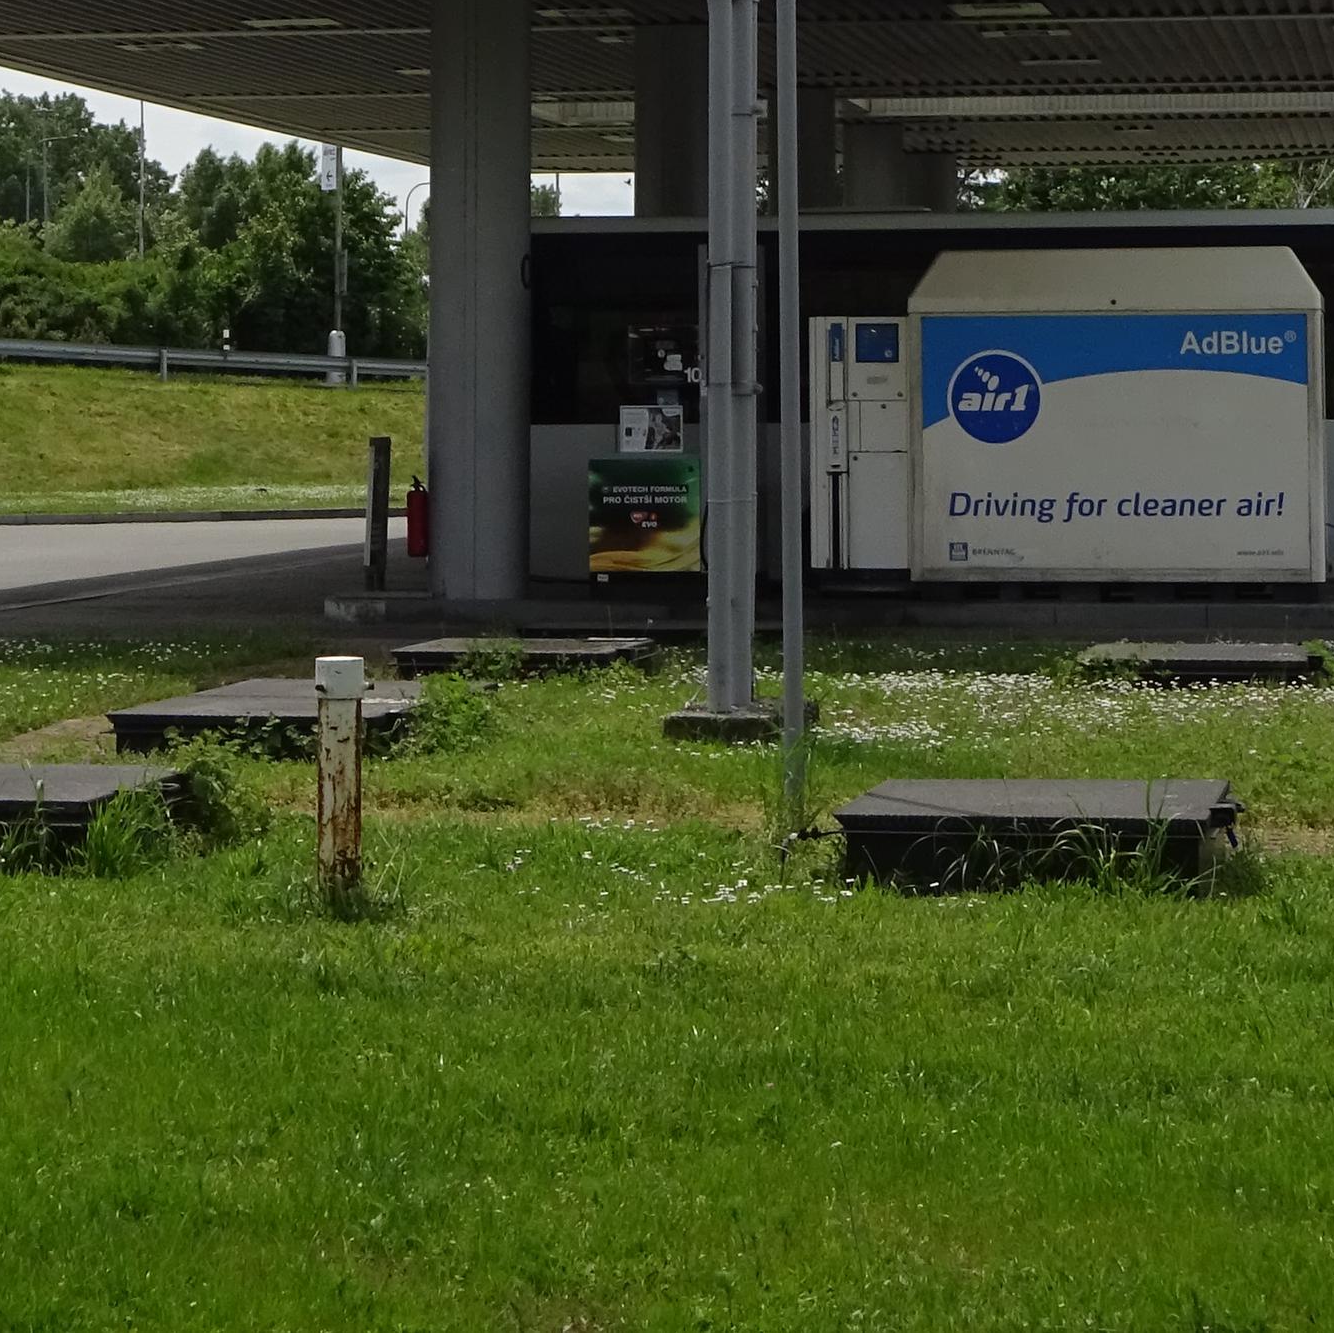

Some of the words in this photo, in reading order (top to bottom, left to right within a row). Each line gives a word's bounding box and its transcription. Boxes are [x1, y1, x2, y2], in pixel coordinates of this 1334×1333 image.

[958, 374, 1029, 411] air1
[603, 496, 622, 504] PRO
[654, 496, 687, 504] MOTOR
[949, 492, 1056, 523] Driving
[1063, 492, 1107, 523] for
[1117, 493, 1226, 517] cleaner
[1236, 492, 1284, 517] air!
